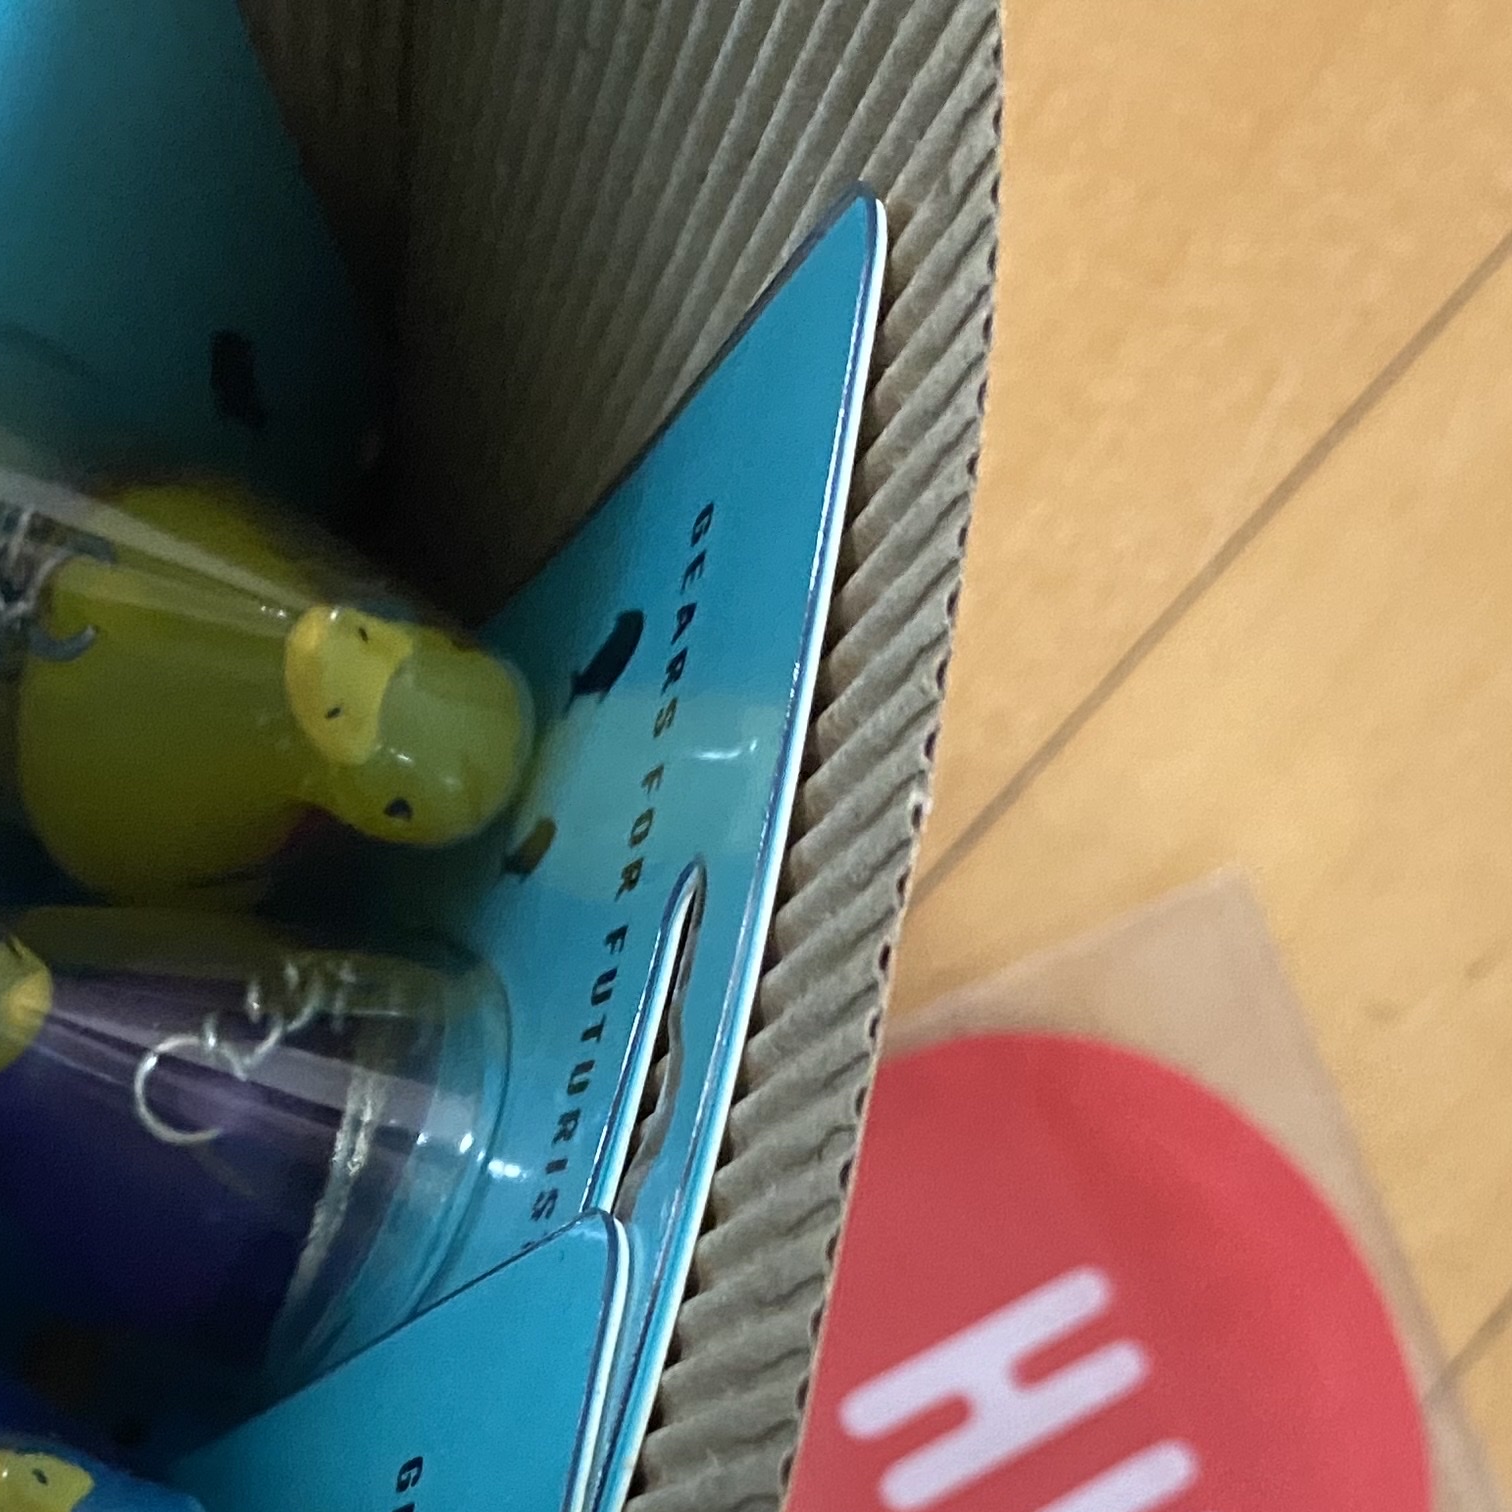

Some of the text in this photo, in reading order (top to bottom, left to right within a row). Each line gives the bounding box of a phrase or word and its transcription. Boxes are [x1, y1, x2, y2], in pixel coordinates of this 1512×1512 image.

[521, 502, 715, 1249] GEARS FOR FUTURIS
